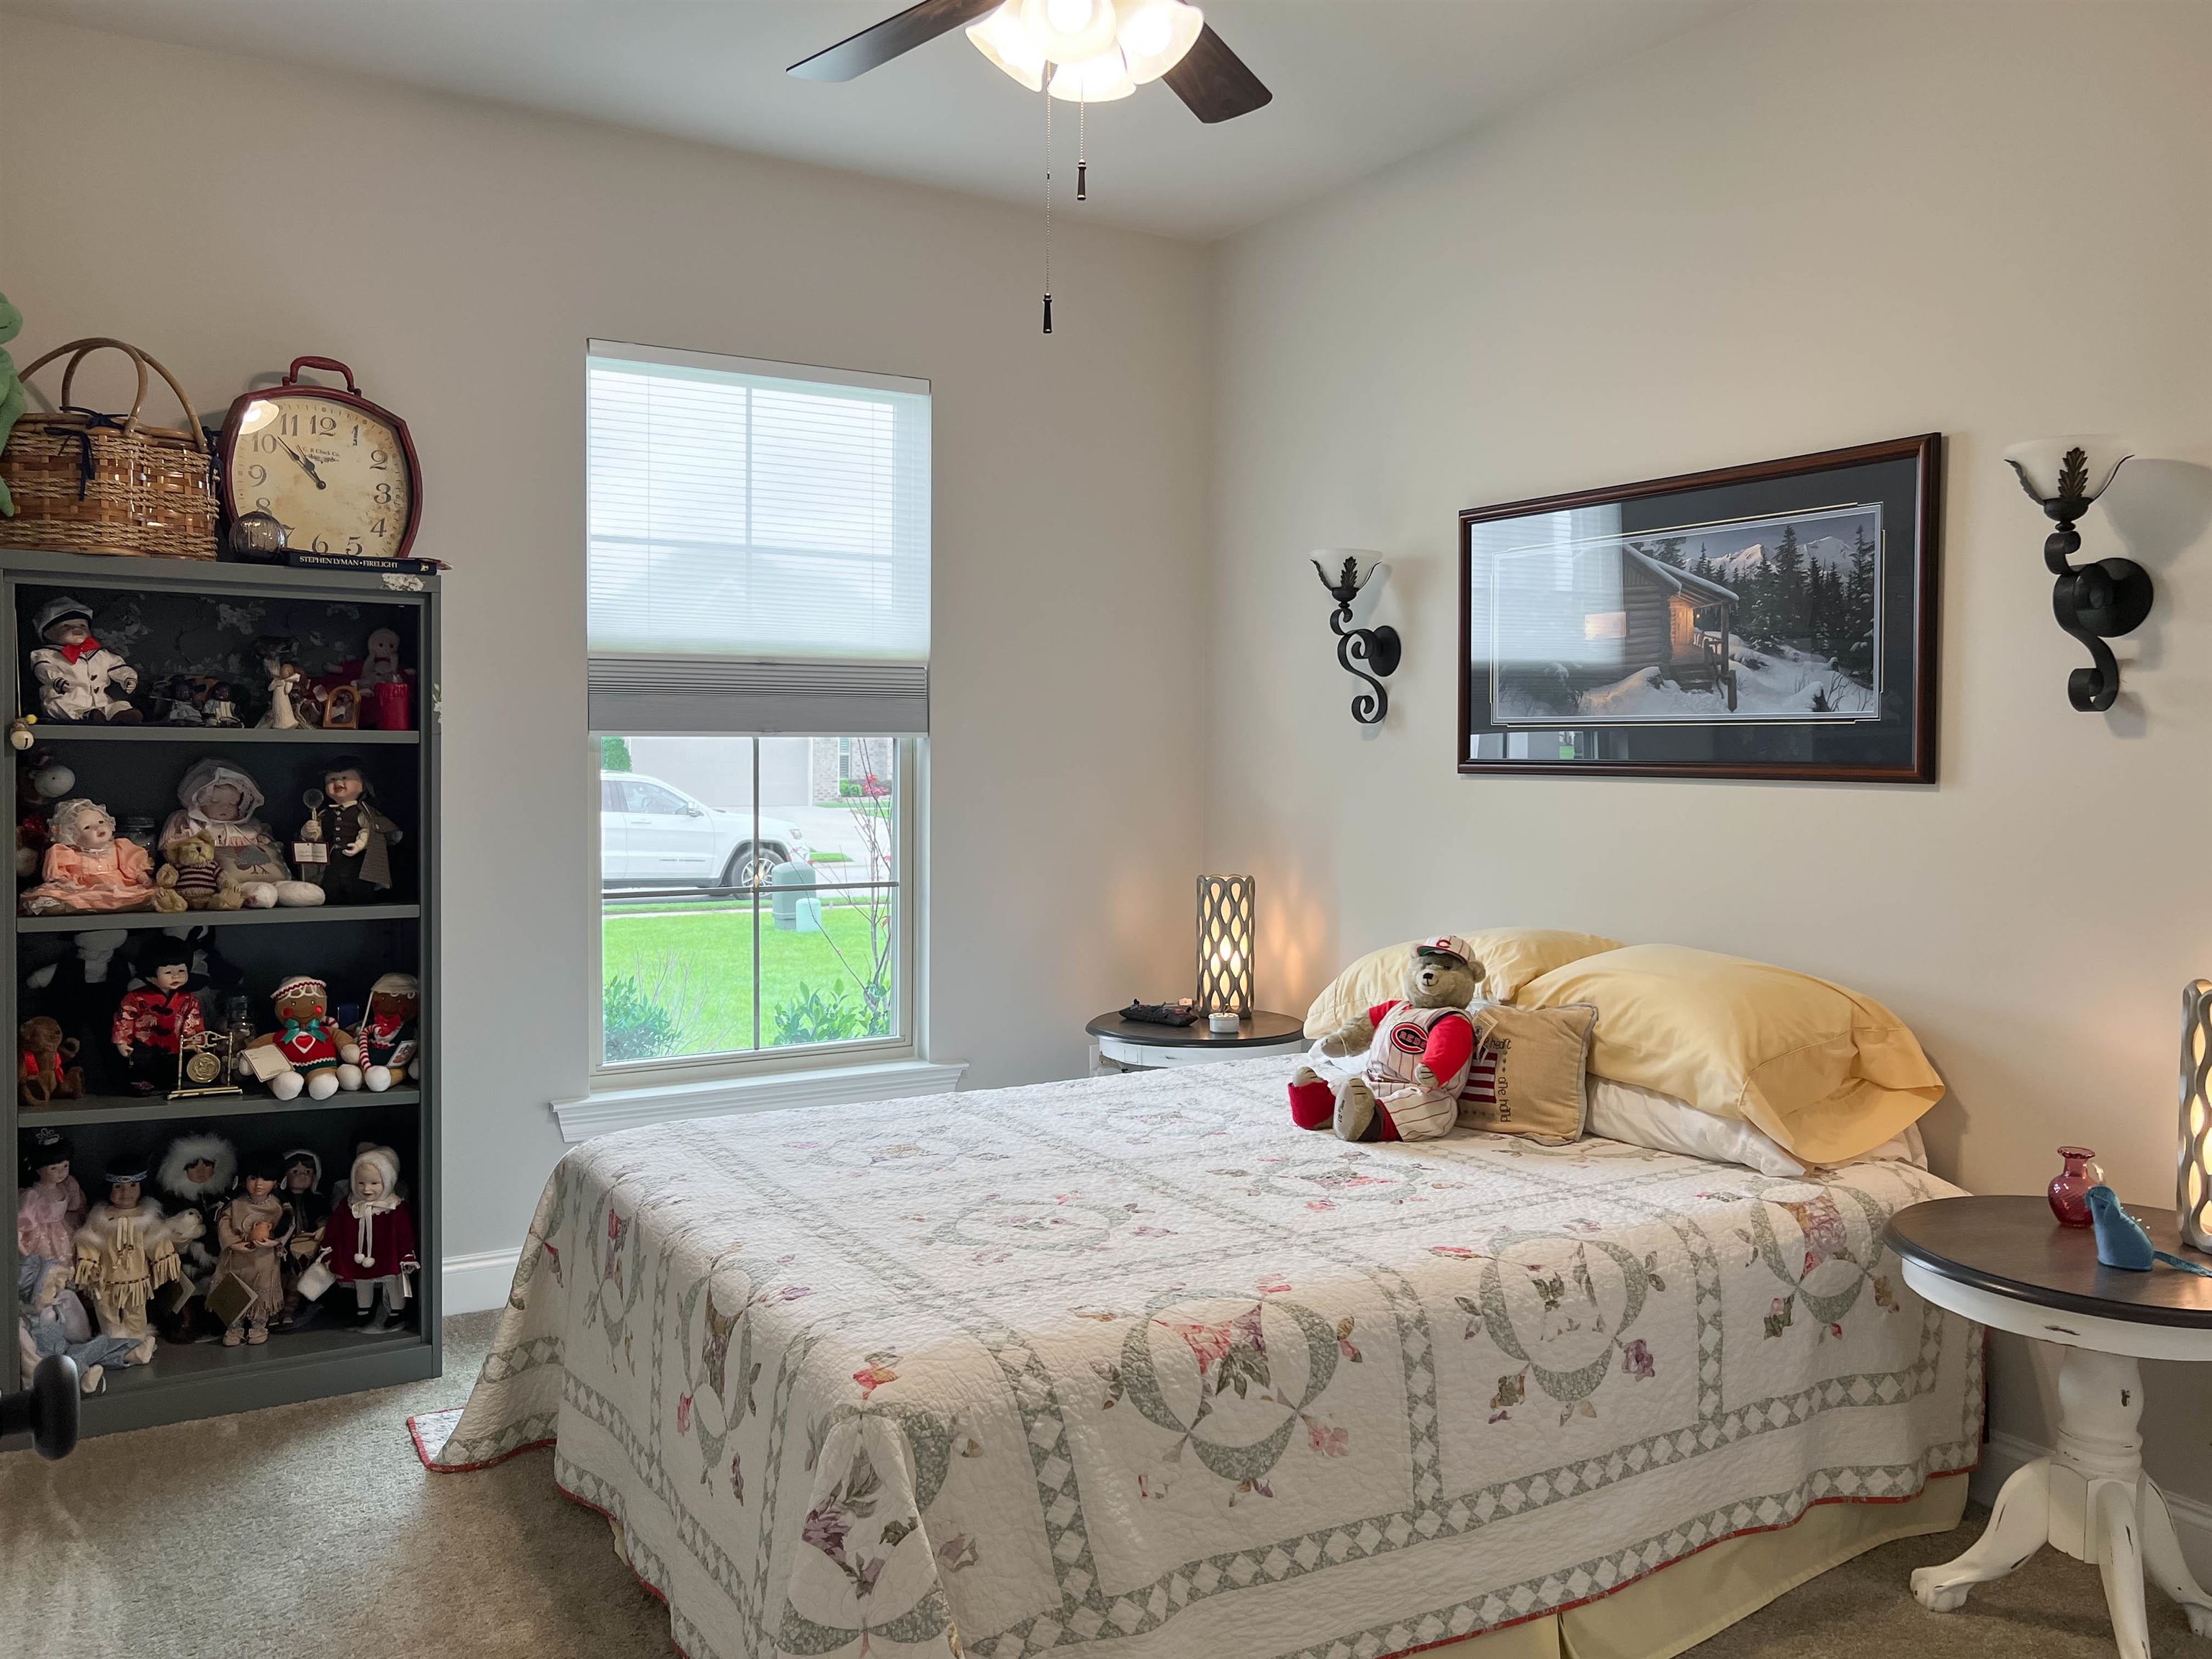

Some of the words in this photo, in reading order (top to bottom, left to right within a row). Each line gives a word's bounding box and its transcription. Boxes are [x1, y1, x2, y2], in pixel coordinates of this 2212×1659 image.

[280, 413, 298, 436] 11
[310, 415, 337, 436] 12
[351, 424, 359, 446] 1
[252, 432, 277, 454] 10
[369, 449, 389, 470] 2
[248, 464, 267, 487] 9
[374, 482, 392, 504] 3
[370, 517, 387, 537] 4
[312, 532, 329, 554] 6
[346, 536, 363, 556] 5
[300, 556, 332, 565] STEPHEN
[362, 560, 399, 569] FIRELIGHT
[1491, 1038, 1511, 1050] heart
[1499, 1099, 1511, 1122] hand
